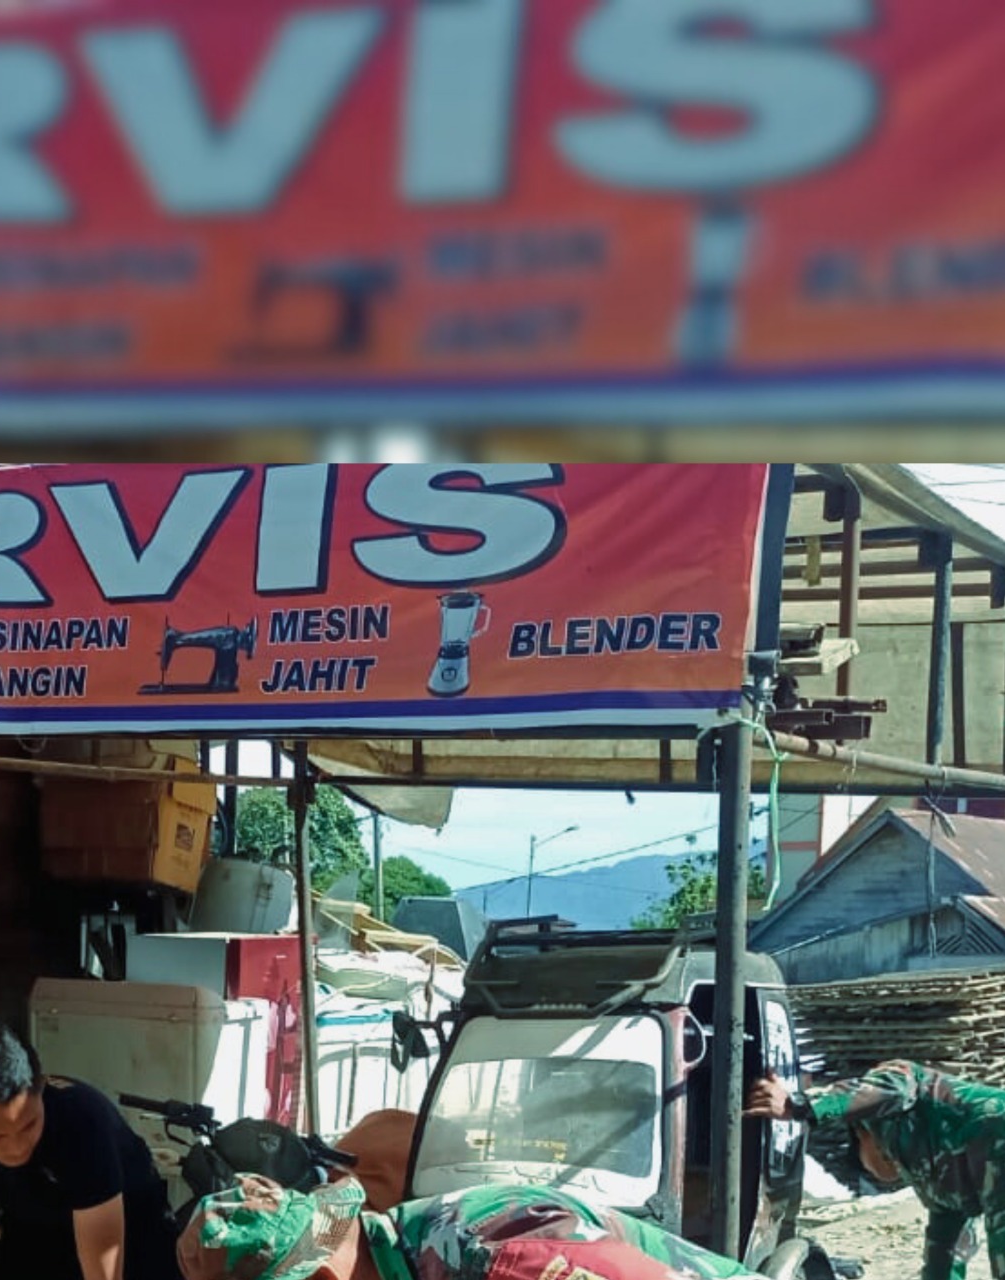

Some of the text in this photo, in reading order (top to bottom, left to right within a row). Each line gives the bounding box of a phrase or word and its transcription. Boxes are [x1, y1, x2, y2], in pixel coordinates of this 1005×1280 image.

[267, 604, 391, 646] MESIN
[507, 612, 723, 660] BLENDER
[259, 656, 378, 694] JAHIT
